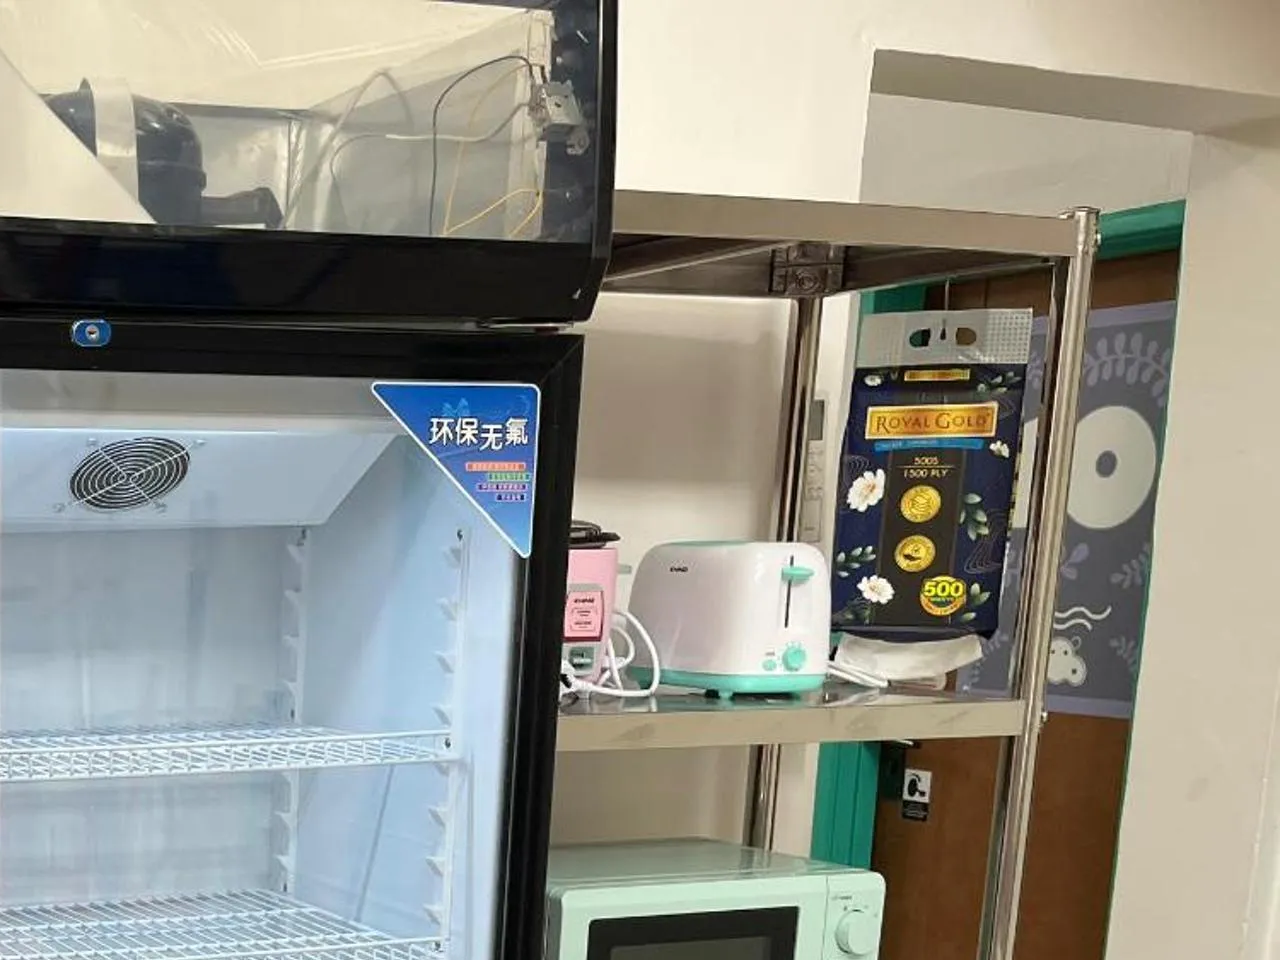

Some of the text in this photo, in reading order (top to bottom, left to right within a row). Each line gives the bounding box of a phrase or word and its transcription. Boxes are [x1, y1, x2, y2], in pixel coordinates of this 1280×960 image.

[429, 417, 529, 450] 环保无氟
[876, 411, 989, 434] ROYAL GOLD
[923, 581, 964, 597] 500
